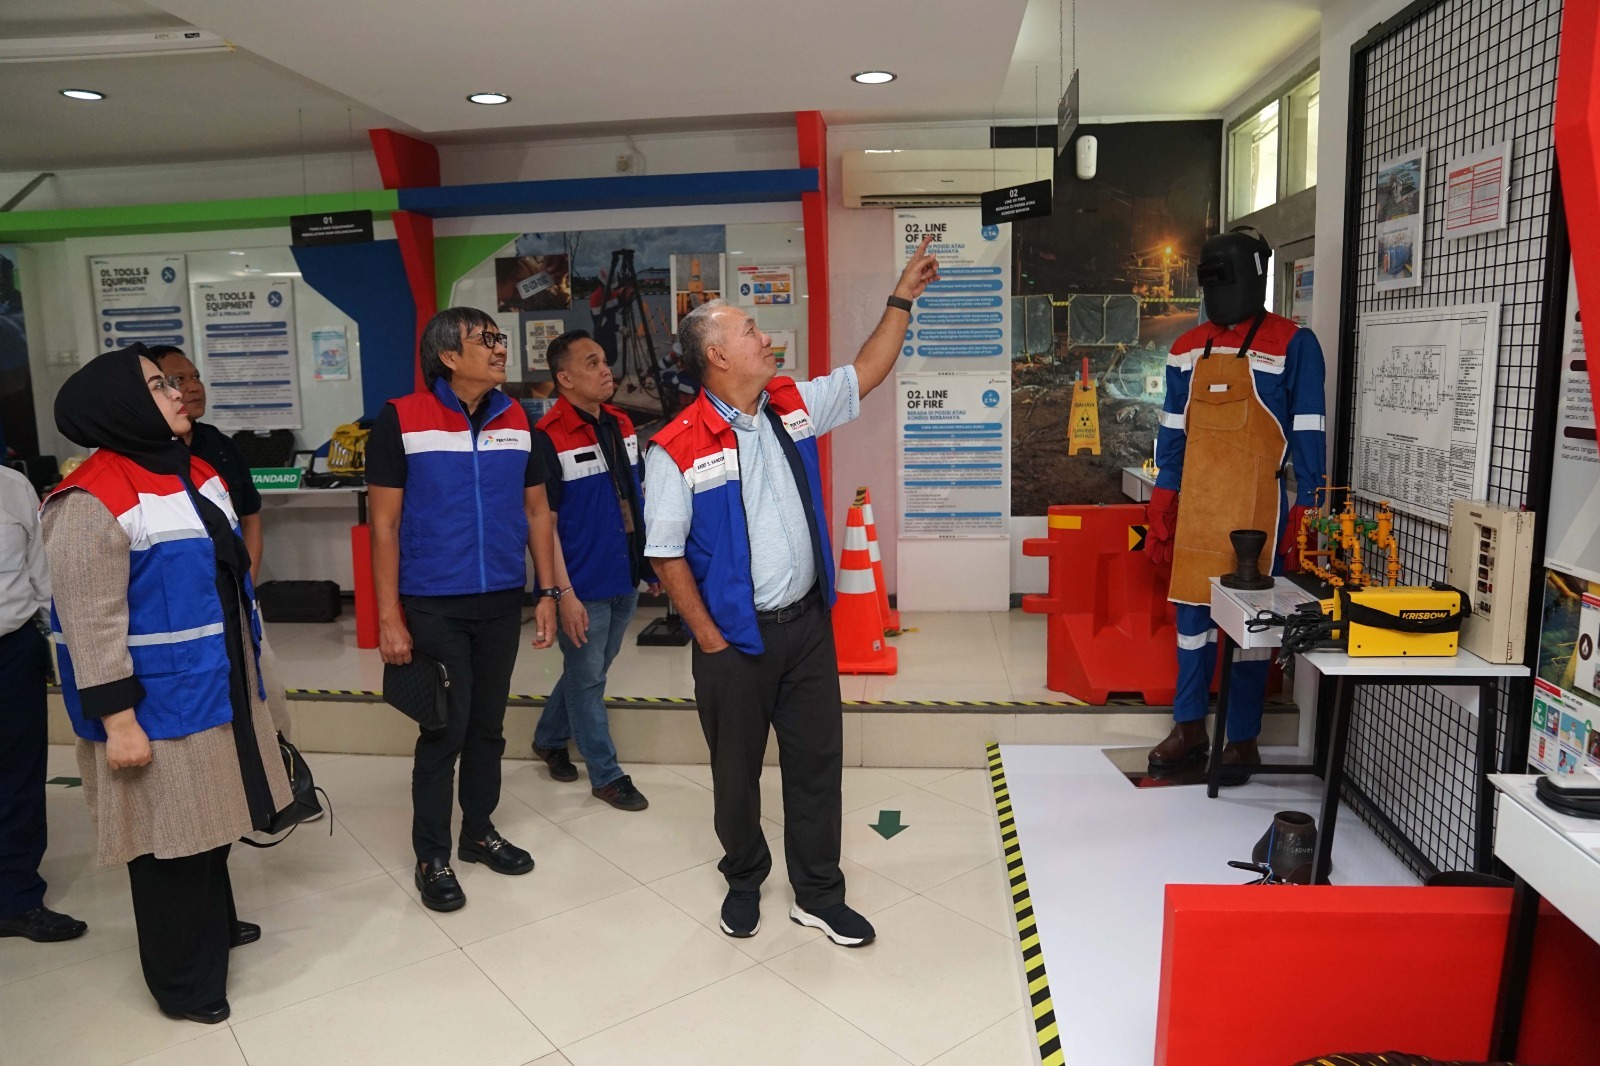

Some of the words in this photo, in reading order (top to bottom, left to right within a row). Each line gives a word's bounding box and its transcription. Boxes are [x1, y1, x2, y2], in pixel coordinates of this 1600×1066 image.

[1009, 188, 1018, 198] 02
[323, 216, 333, 224] 01
[905, 224, 922, 233] 02.
[925, 223, 947, 232] LINE
[905, 234, 920, 243] OF
[922, 234, 942, 242] FRE
[113, 268, 141, 276] TOOLS
[102, 277, 147, 286] EQUIPMENT
[219, 292, 246, 301] TOOLS
[249, 292, 255, 300] &
[206, 301, 253, 311] EQUIPMENT
[907, 390, 924, 399] 02.
[927, 390, 948, 398] LINE
[907, 400, 921, 408] OF
[923, 400, 943, 408] FIRE
[252, 475, 297, 483] TANDARD
